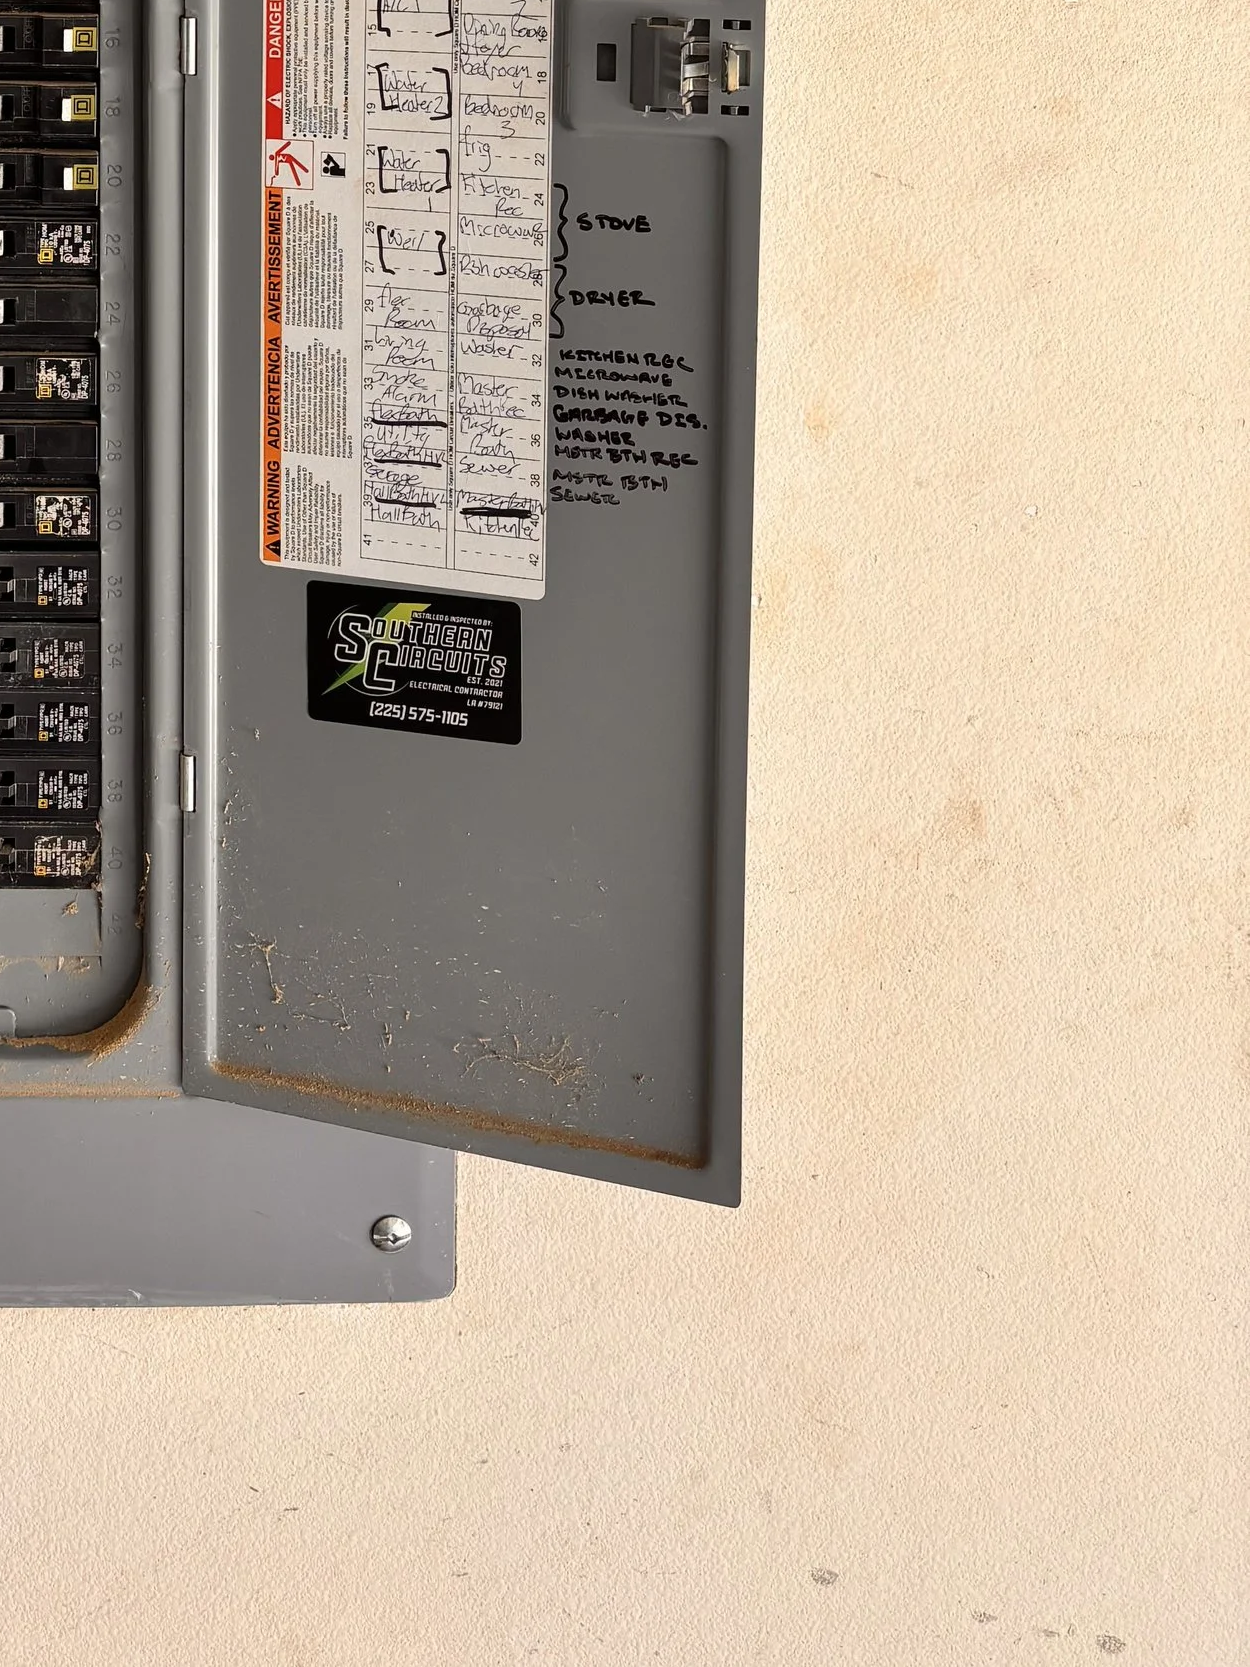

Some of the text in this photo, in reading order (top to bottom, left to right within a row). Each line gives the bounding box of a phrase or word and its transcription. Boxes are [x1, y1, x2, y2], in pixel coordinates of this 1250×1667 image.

[535, 153, 545, 166] 22
[534, 193, 544, 206] 24
[577, 212, 651, 232] STOVE
[268, 190, 282, 323] AVERTISSEMENT
[569, 290, 655, 306] DRYER
[560, 349, 639, 364] KITCHEN
[555, 367, 672, 386] MICROWAVE
[267, 337, 281, 449] ADVERTENCIA
[553, 386, 688, 407] DISH WASHER
[553, 404, 707, 429] GARBAGE DIS.
[555, 427, 635, 446] WASHER
[555, 445, 698, 468] MSTR BTH REC
[553, 469, 667, 491] MSTR BTH
[267, 461, 280, 535] WARNING
[550, 486, 620, 504] SEWER
[412, 612, 444, 621] INSTALLED
[450, 616, 482, 626] INSPECTED
[334, 613, 492, 662] SOUTHERN
[363, 640, 507, 691] CIRCUITS
[410, 681, 503, 698] ELECTRICAL CONTRACTOR
[467, 677, 503, 687] EST. 2021
[370, 702, 468, 726] (225) 575-1105
[477, 700, 503, 710] #79121
